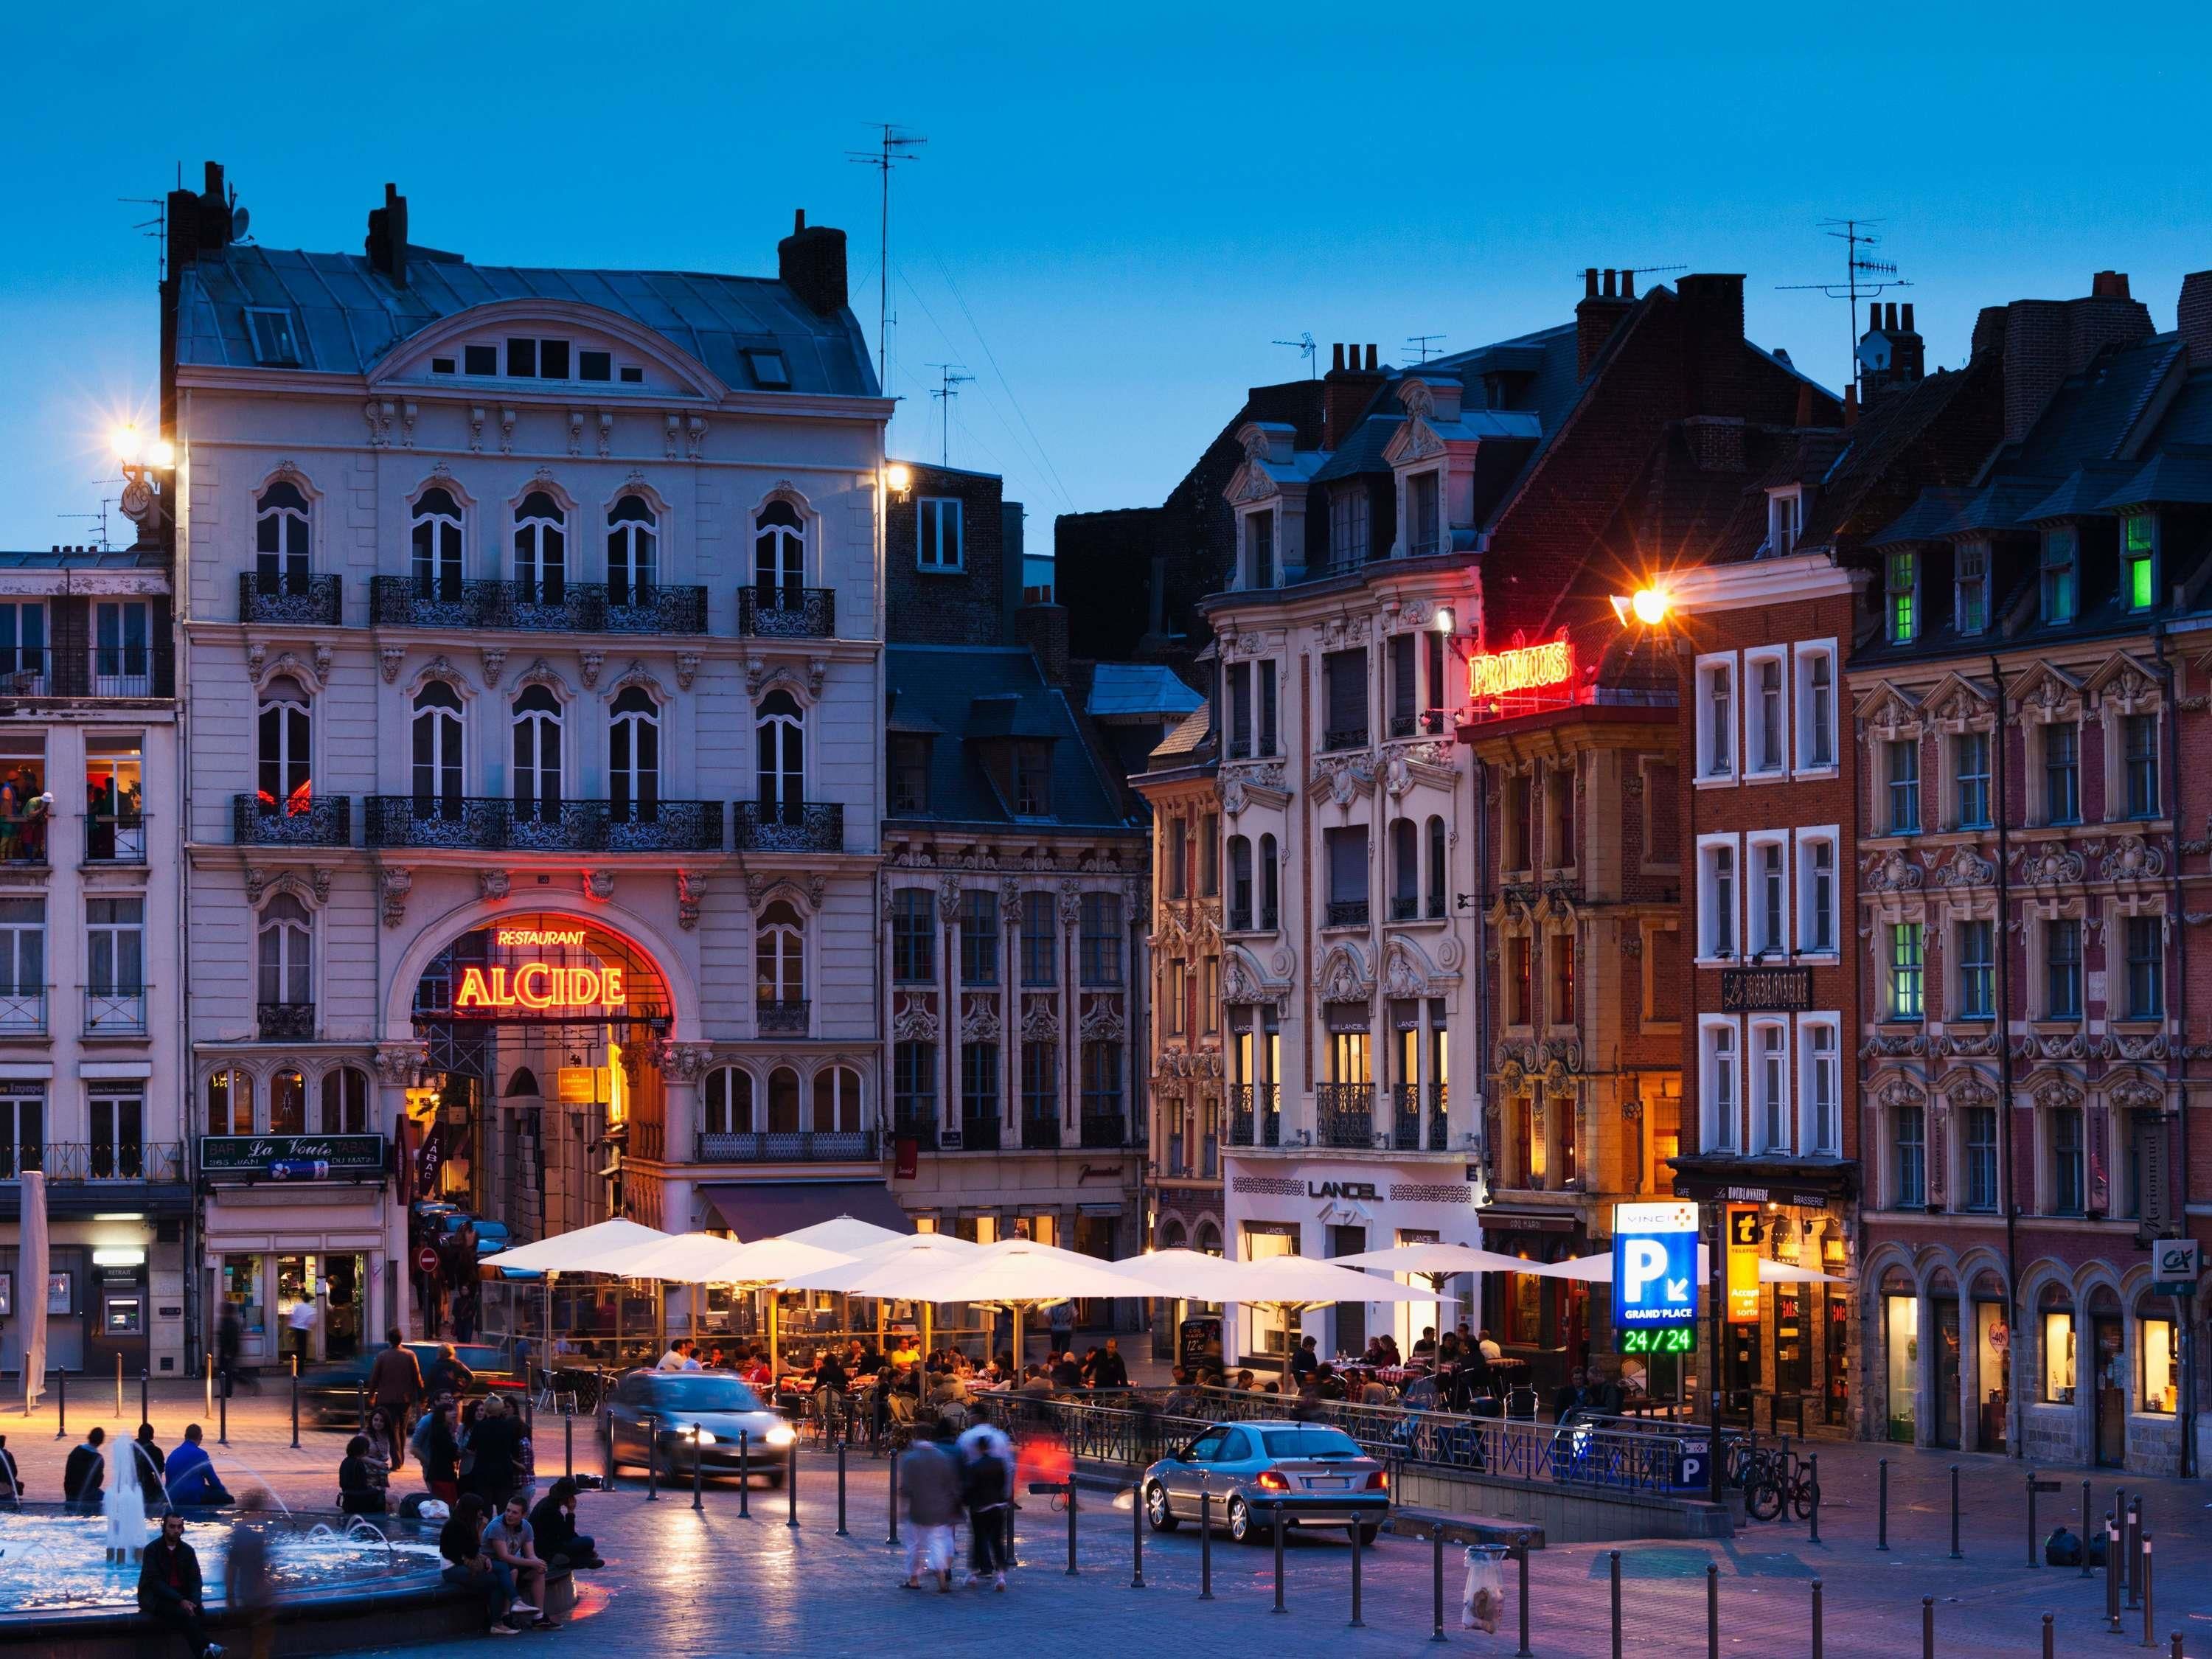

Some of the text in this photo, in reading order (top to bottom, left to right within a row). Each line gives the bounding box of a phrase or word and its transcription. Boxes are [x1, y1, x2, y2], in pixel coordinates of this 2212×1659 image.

[1470, 641, 1568, 697] PRIMUS
[498, 931, 586, 945] RESTAURANT
[456, 962, 626, 1009] ALCIDE
[209, 1144, 236, 1156] BAR
[248, 1139, 274, 1158] La
[335, 1141, 375, 1153] TABAC
[424, 1138, 441, 1180] TABAC
[1308, 1181, 1384, 1201] LANCEL
[1793, 1194, 1824, 1206] BRASSERIE
[1624, 1239, 1668, 1303] P
[1624, 1308, 1693, 1320] GRAND'PLACE
[1683, 1458, 1700, 1483] P
